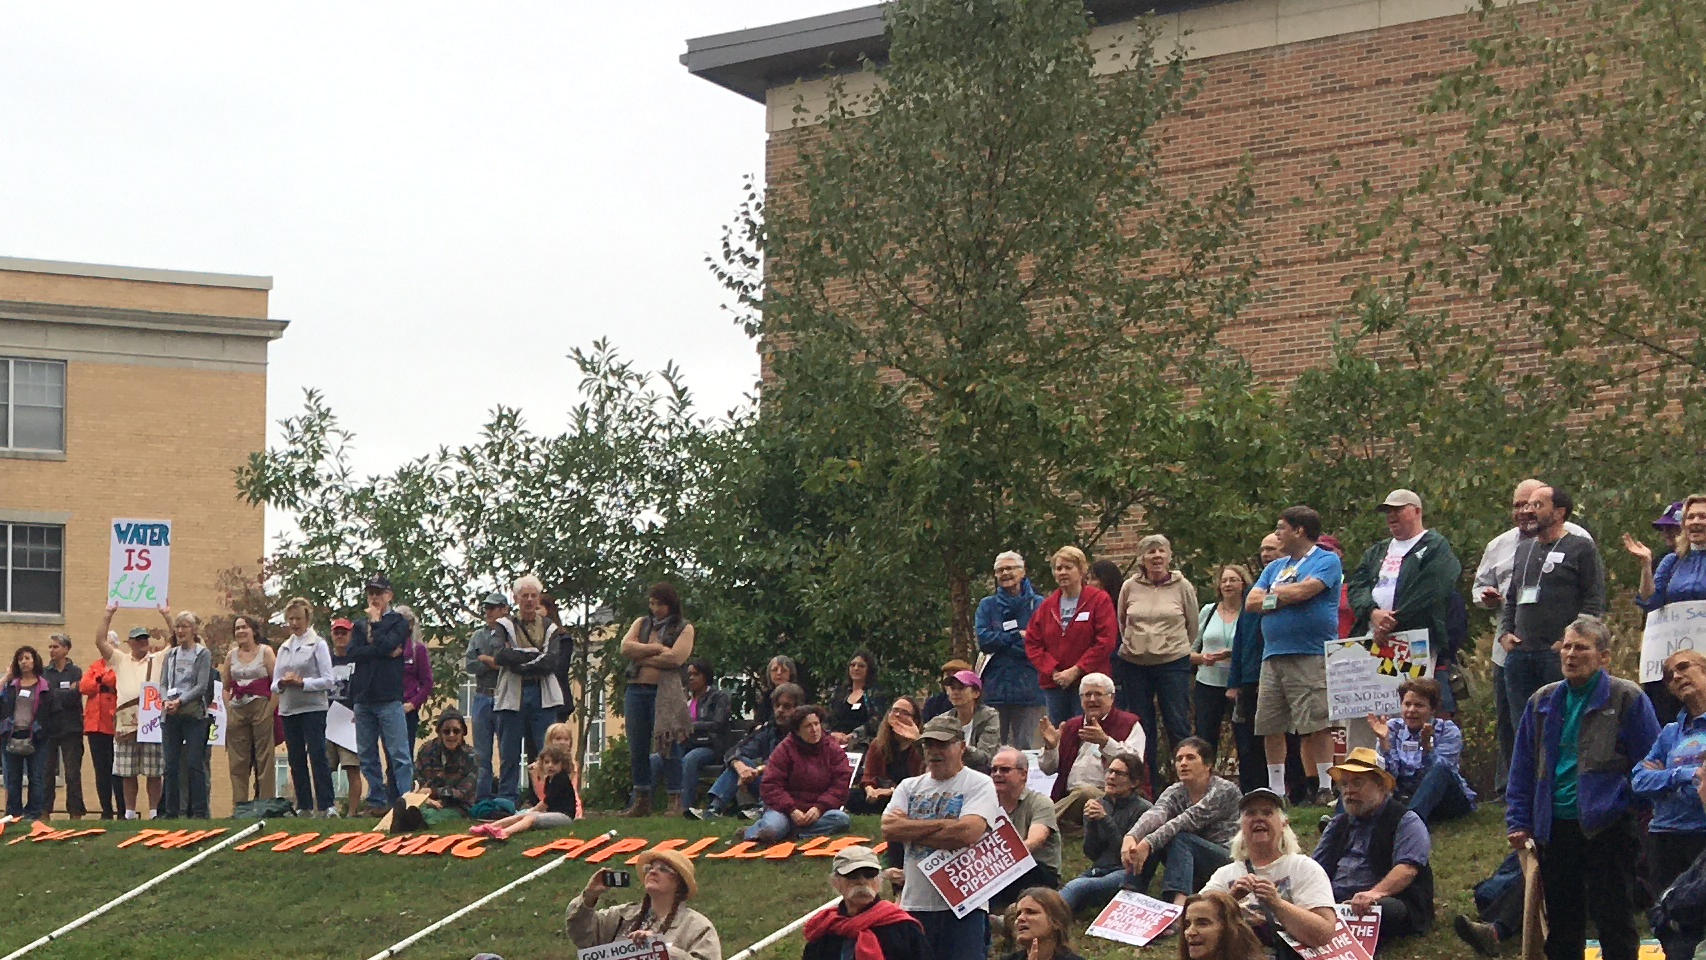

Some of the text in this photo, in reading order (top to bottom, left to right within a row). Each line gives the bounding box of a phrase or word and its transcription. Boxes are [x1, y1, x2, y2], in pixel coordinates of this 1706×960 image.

[114, 523, 170, 546] WATER
[123, 548, 152, 571] IS
[109, 573, 156, 602] Life
[1354, 691, 1372, 702] NO
[233, 831, 488, 858] POTOMAC
[944, 830, 1004, 877] STOP THE
[924, 852, 950, 871] GOV.
[949, 840, 1012, 889] POTOMAC
[959, 852, 1016, 897] PIPELINE!
[1108, 910, 1156, 931] POTOMAC
[1116, 903, 1165, 925] STOP THE
[1331, 932, 1353, 950] THE
[1350, 924, 1374, 937] THE
